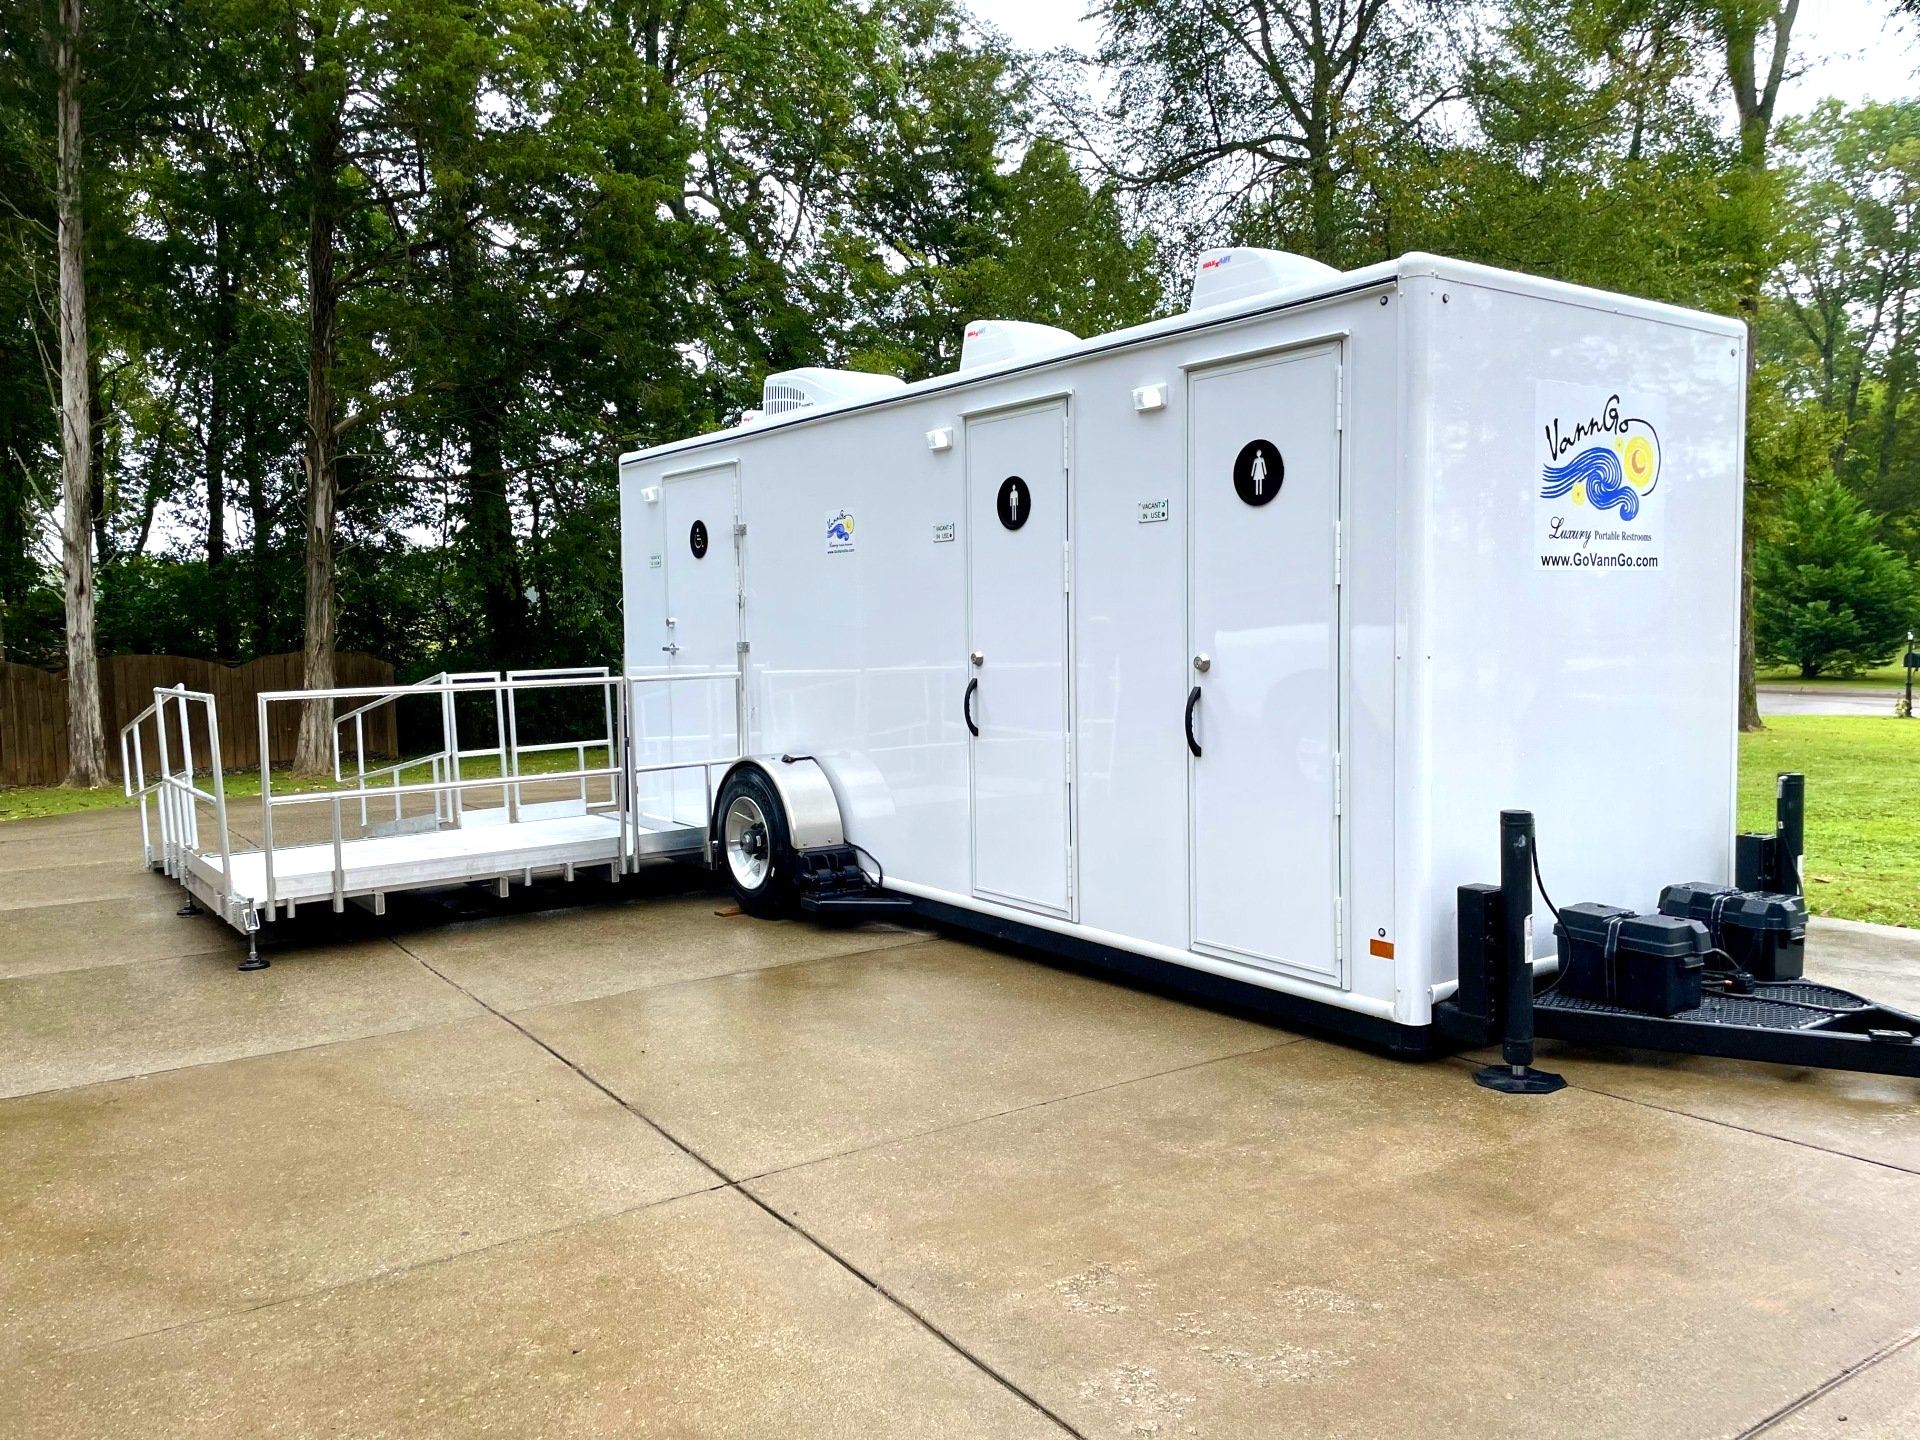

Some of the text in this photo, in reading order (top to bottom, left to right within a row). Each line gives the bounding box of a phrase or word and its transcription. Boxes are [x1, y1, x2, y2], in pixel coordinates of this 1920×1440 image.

[1545, 394, 1640, 462] VannGo
[1142, 502, 1161, 510] VACANT
[1549, 516, 1652, 548] Luxury Portable Restrooms
[1541, 552, 1658, 567] www.GoVannGo.com
